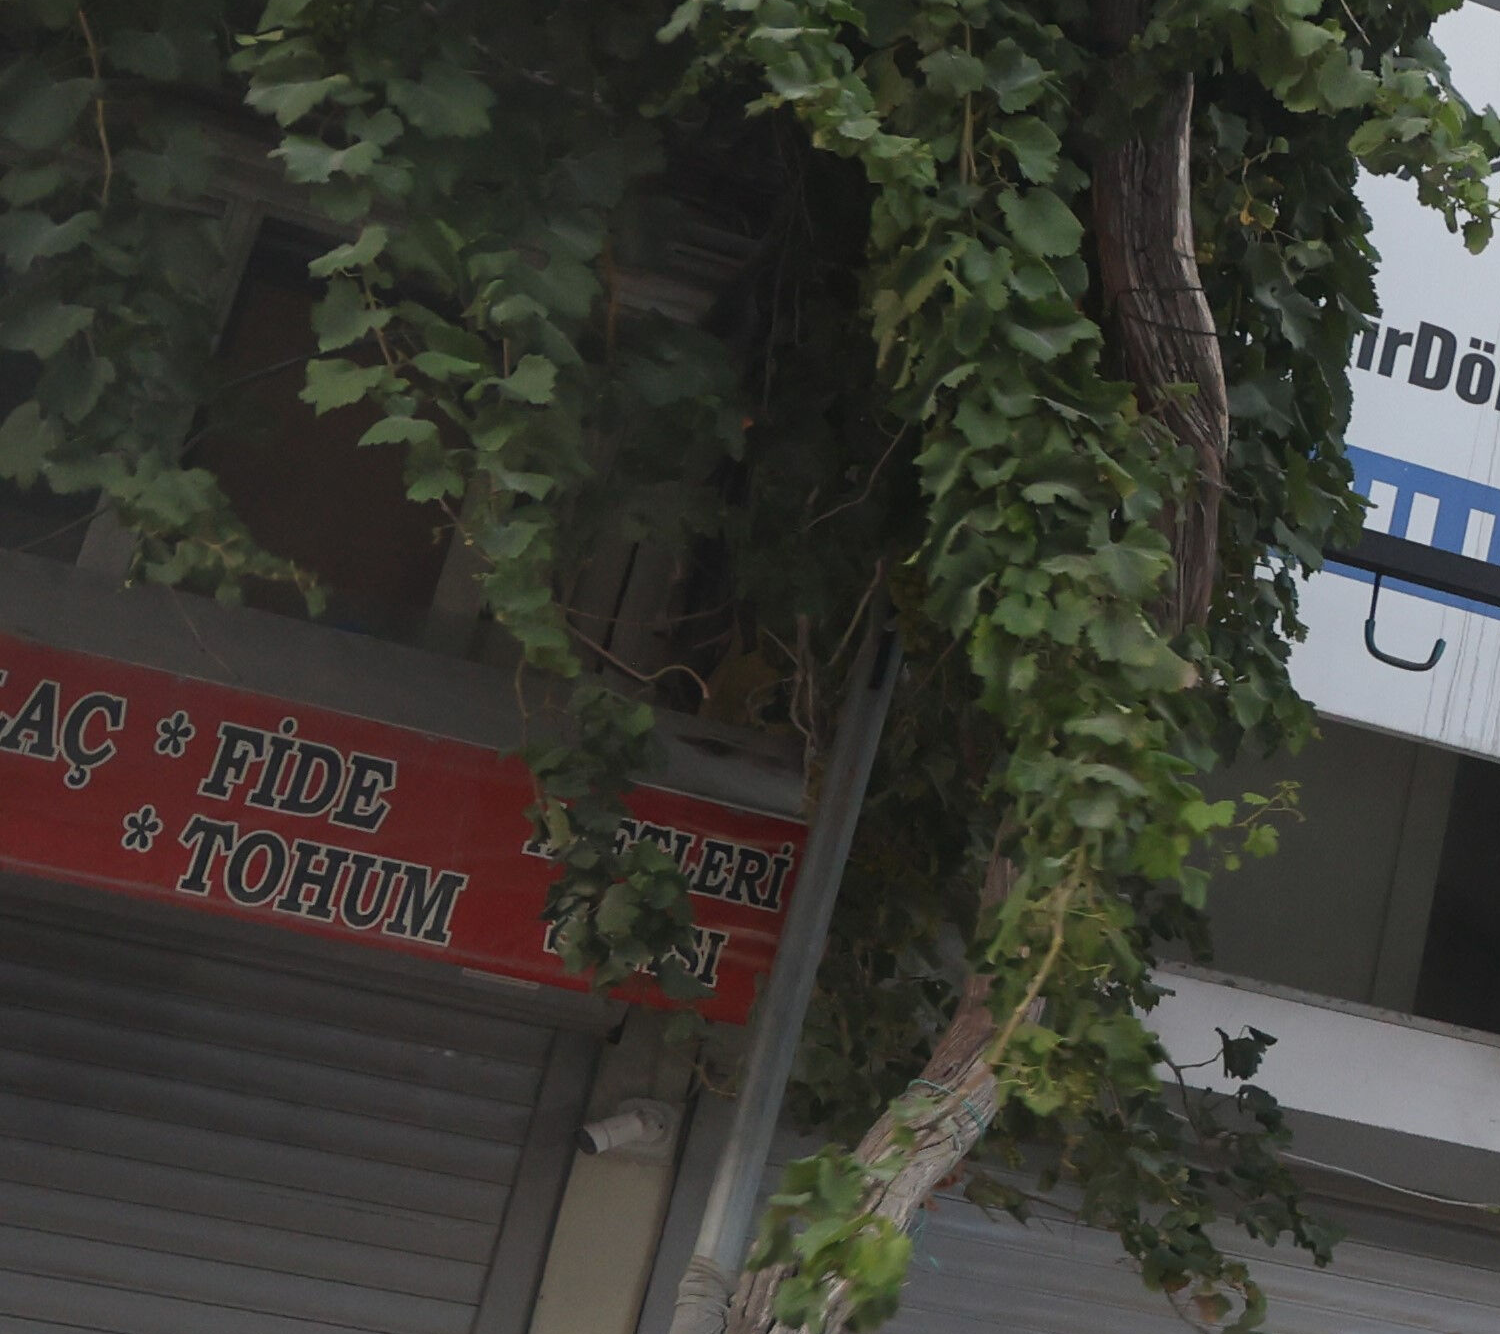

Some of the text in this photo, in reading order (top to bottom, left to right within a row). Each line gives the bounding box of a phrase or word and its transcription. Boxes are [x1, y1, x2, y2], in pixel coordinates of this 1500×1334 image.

[0, 670, 127, 788] AÇ
[198, 717, 397, 833] FİDE
[176, 814, 469, 947] TOHUM
